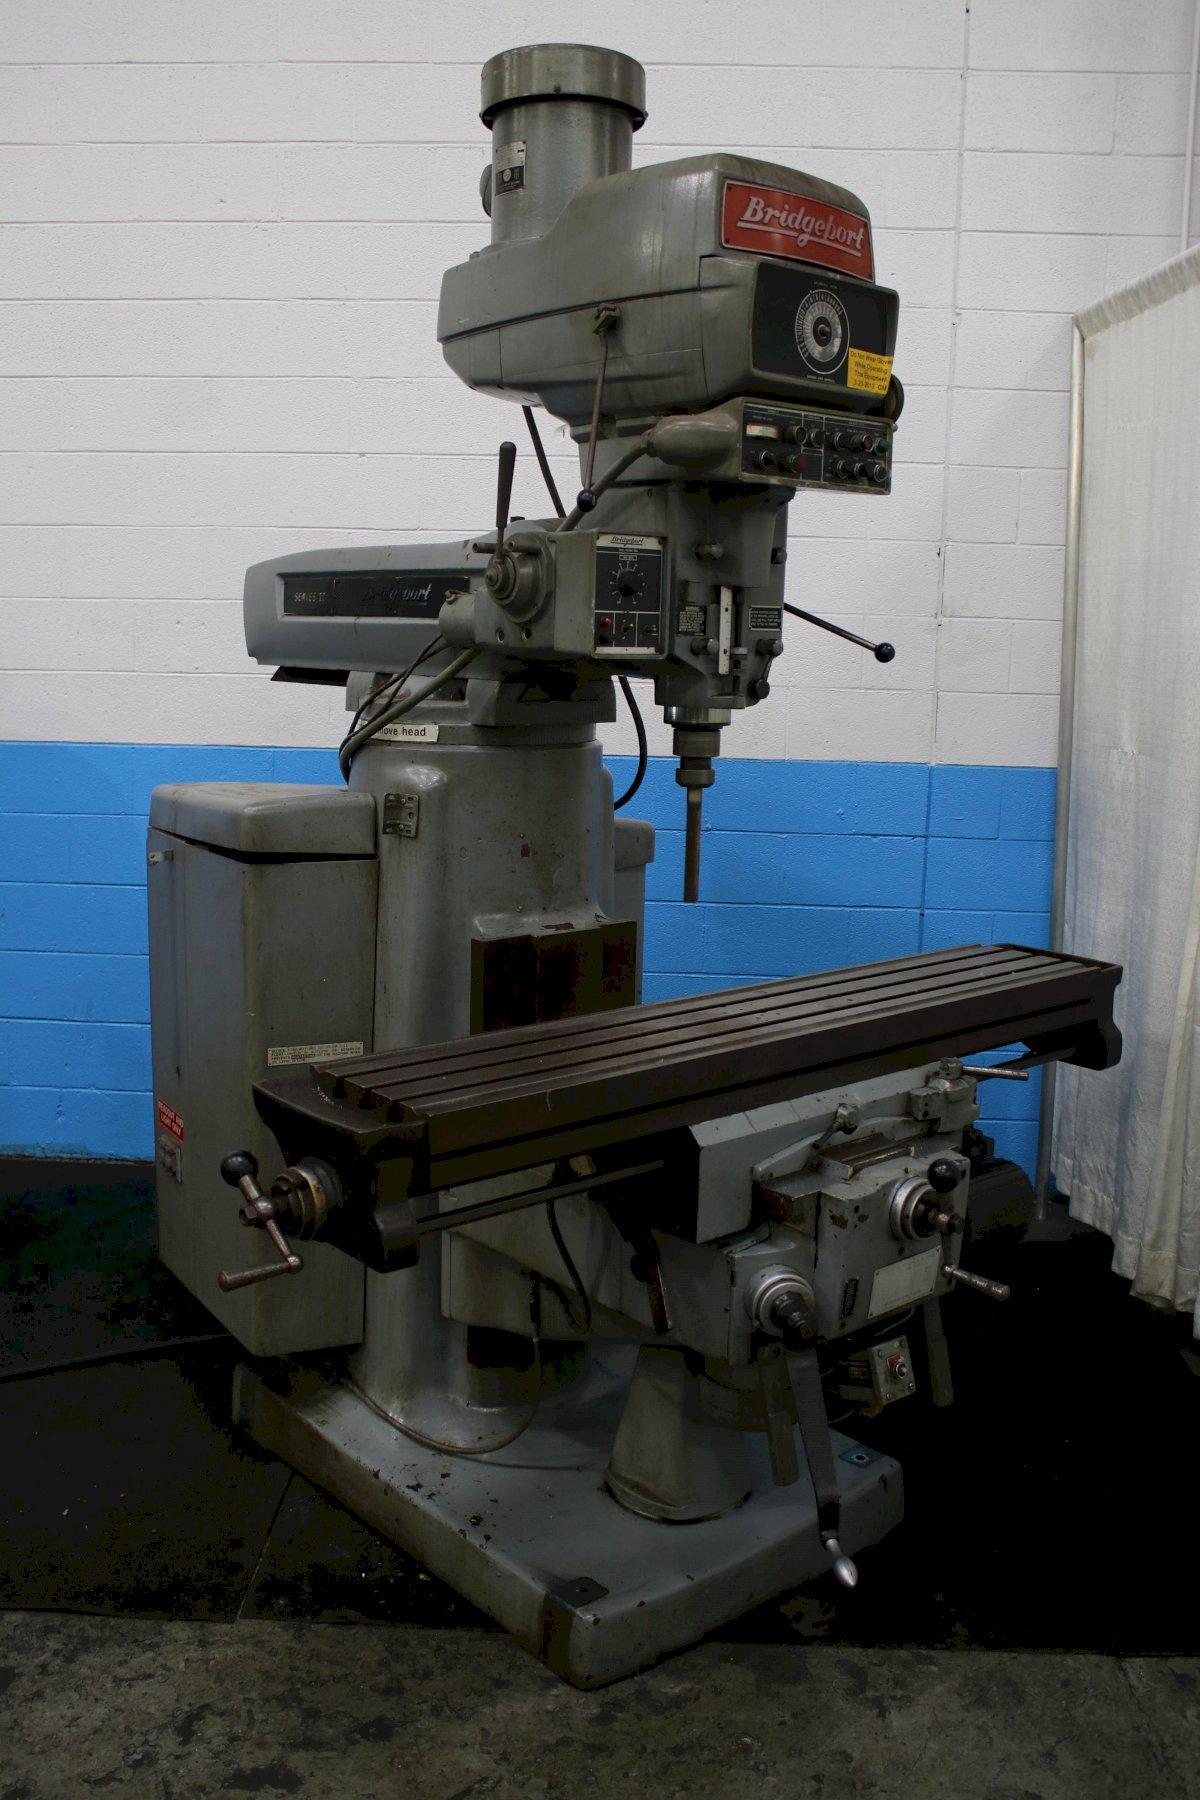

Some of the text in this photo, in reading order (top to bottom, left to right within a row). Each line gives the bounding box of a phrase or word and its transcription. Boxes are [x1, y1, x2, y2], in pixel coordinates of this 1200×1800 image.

[738, 195, 865, 256] Bridgeport
[866, 364, 888, 374] Operating
[610, 535, 644, 547] Bridgeport
[402, 726, 426, 737] head
